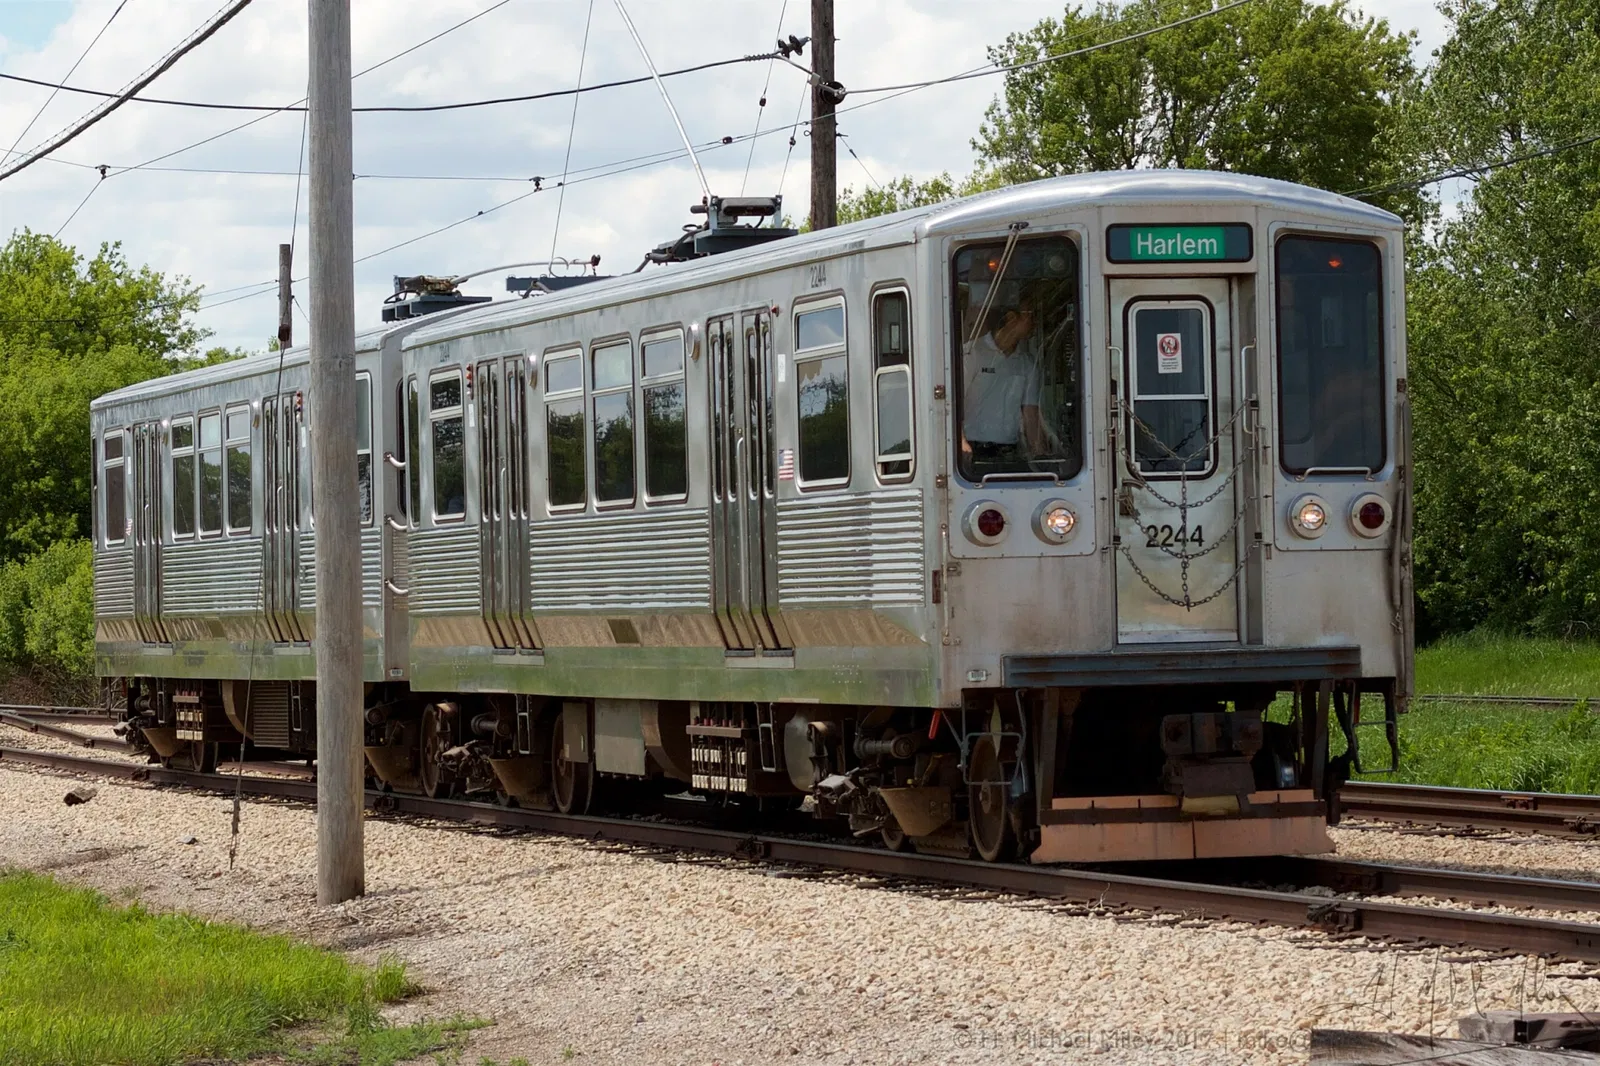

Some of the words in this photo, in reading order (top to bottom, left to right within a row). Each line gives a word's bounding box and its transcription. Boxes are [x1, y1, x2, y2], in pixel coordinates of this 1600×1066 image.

[1137, 232, 1218, 256] Harlem
[810, 263, 827, 288] 2244
[1146, 524, 1205, 547] 2244
